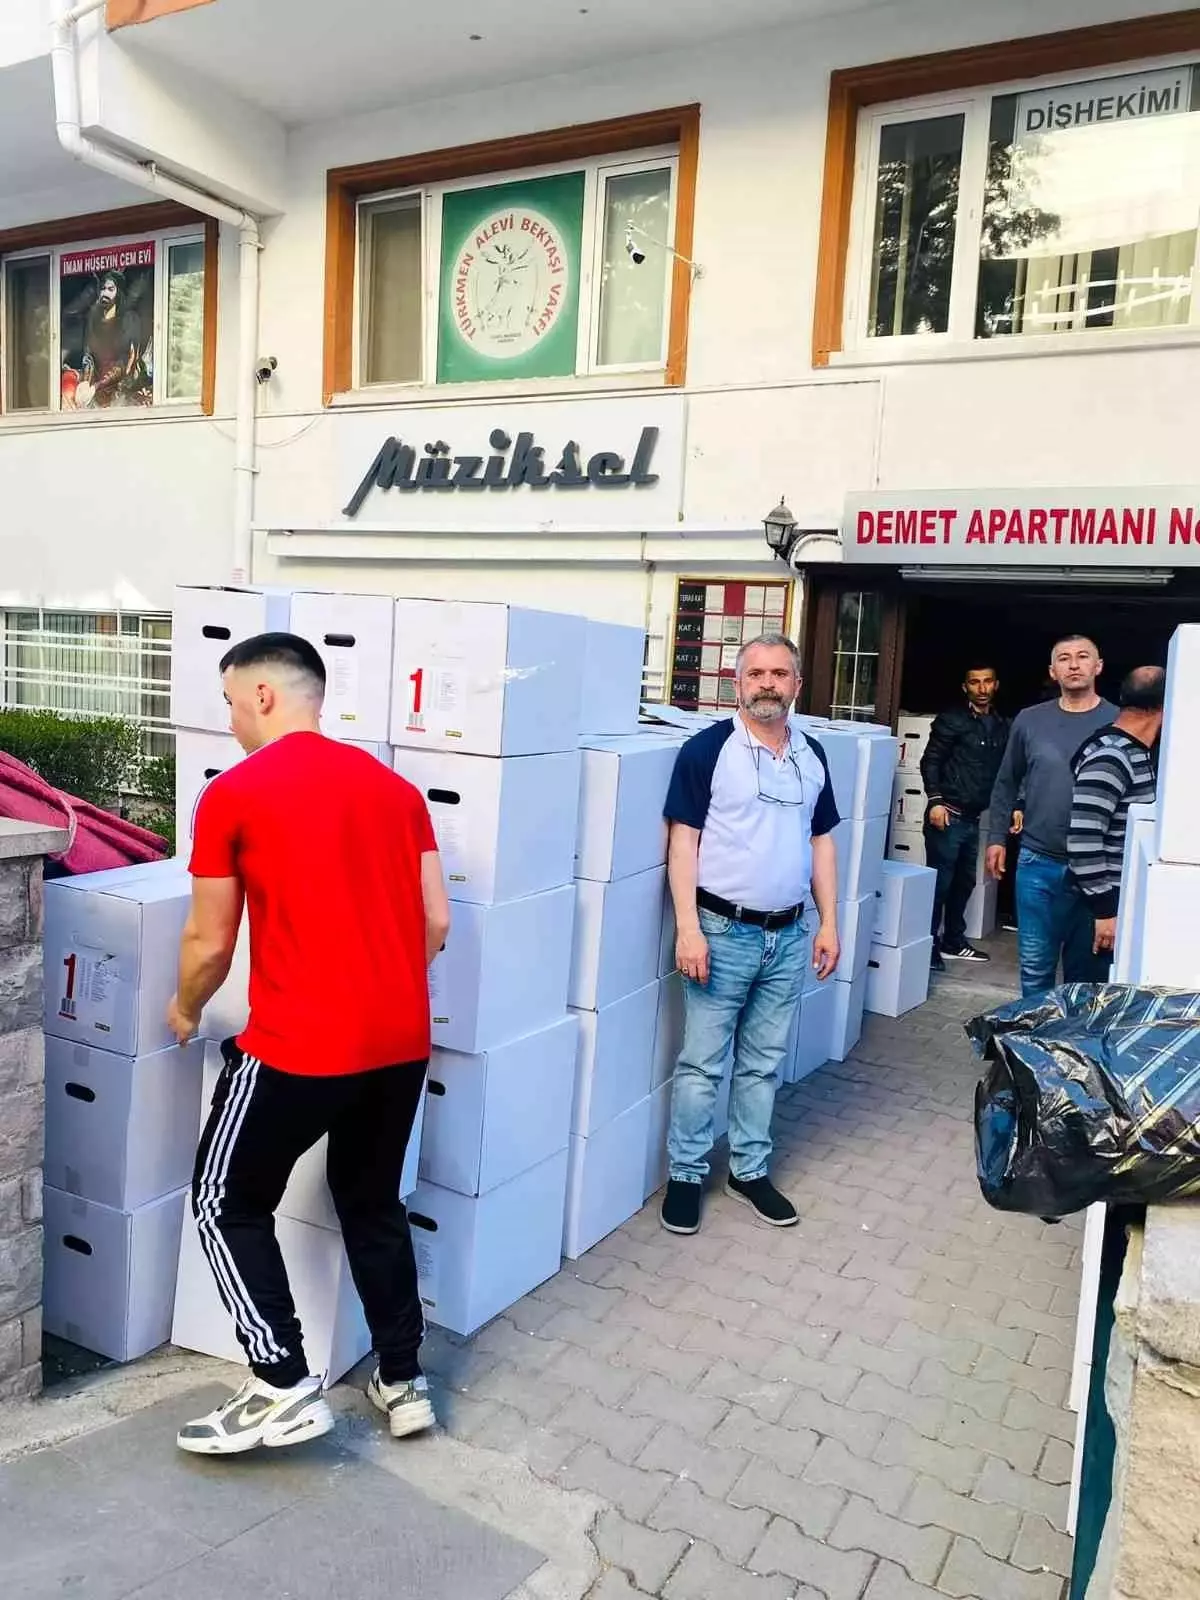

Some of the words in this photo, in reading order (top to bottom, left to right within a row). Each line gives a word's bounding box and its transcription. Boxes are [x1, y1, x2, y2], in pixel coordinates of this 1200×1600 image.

[1026, 80, 1181, 131] DİŞHEKİMİ
[475, 213, 514, 249] ALEVİ
[520, 217, 564, 275] BEKTAŞİ
[63, 257, 83, 275] İMAM
[119, 250, 137, 267] CEM
[456, 252, 477, 340] TÜRKMEN
[533, 284, 562, 337] VAKFI
[342, 426, 660, 517] Müziksel
[856, 510, 958, 545] DEMET
[964, 507, 1157, 545] APARTMANI
[678, 623, 692, 632] KAT
[409, 668, 423, 713] 1
[899, 742, 906, 760] 1
[898, 798, 904, 815] 1
[63, 952, 76, 1000] 1
